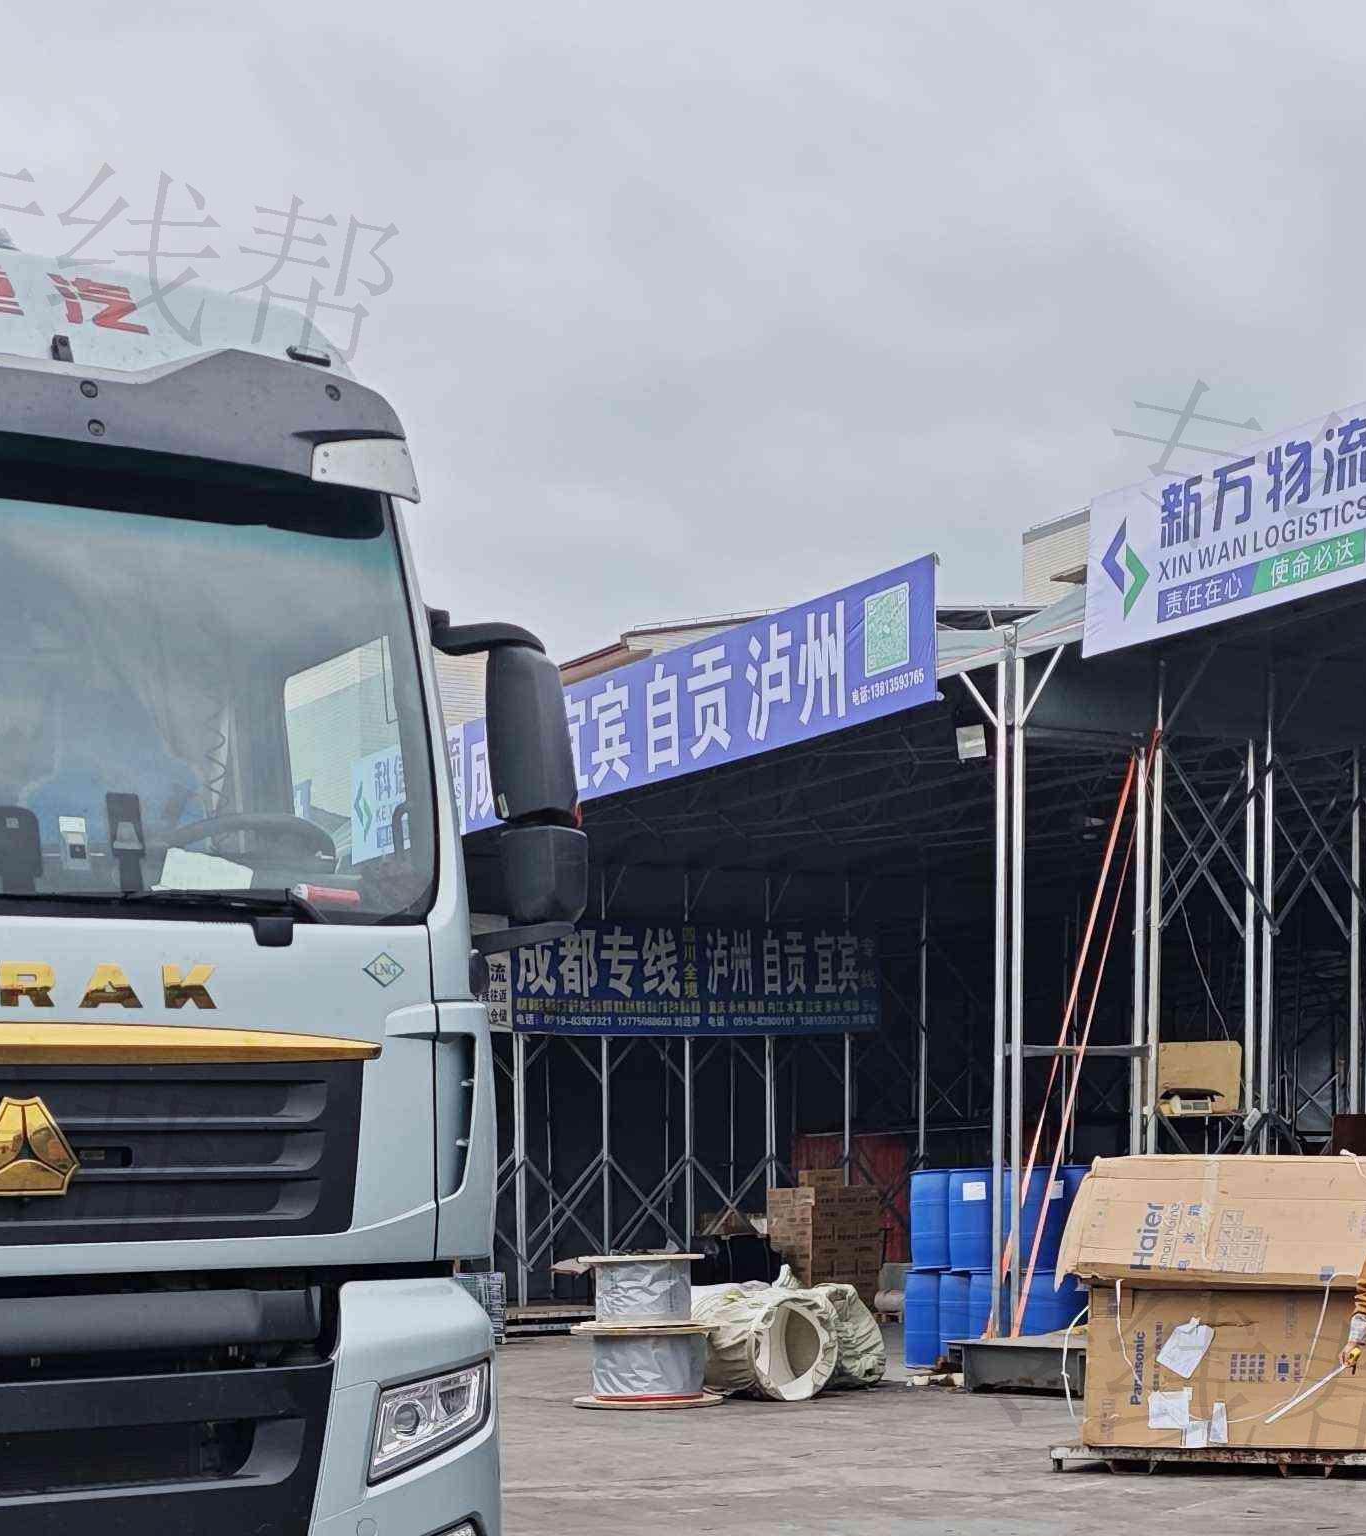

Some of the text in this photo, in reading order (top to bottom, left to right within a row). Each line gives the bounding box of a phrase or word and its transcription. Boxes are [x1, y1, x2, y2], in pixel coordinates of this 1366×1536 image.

[1157, 550, 1192, 584] XIN
[1197, 534, 1248, 570] WAN
[1164, 538, 1356, 619] 责任在心 使命必达
[374, 962, 396, 977] LNG
[517, 925, 682, 999] 成都专线
[763, 929, 807, 996] 自贡
[813, 929, 860, 996] 宜宾
[1129, 1202, 1165, 1271] Haier
[1129, 1330, 1147, 1406] Panasonic
